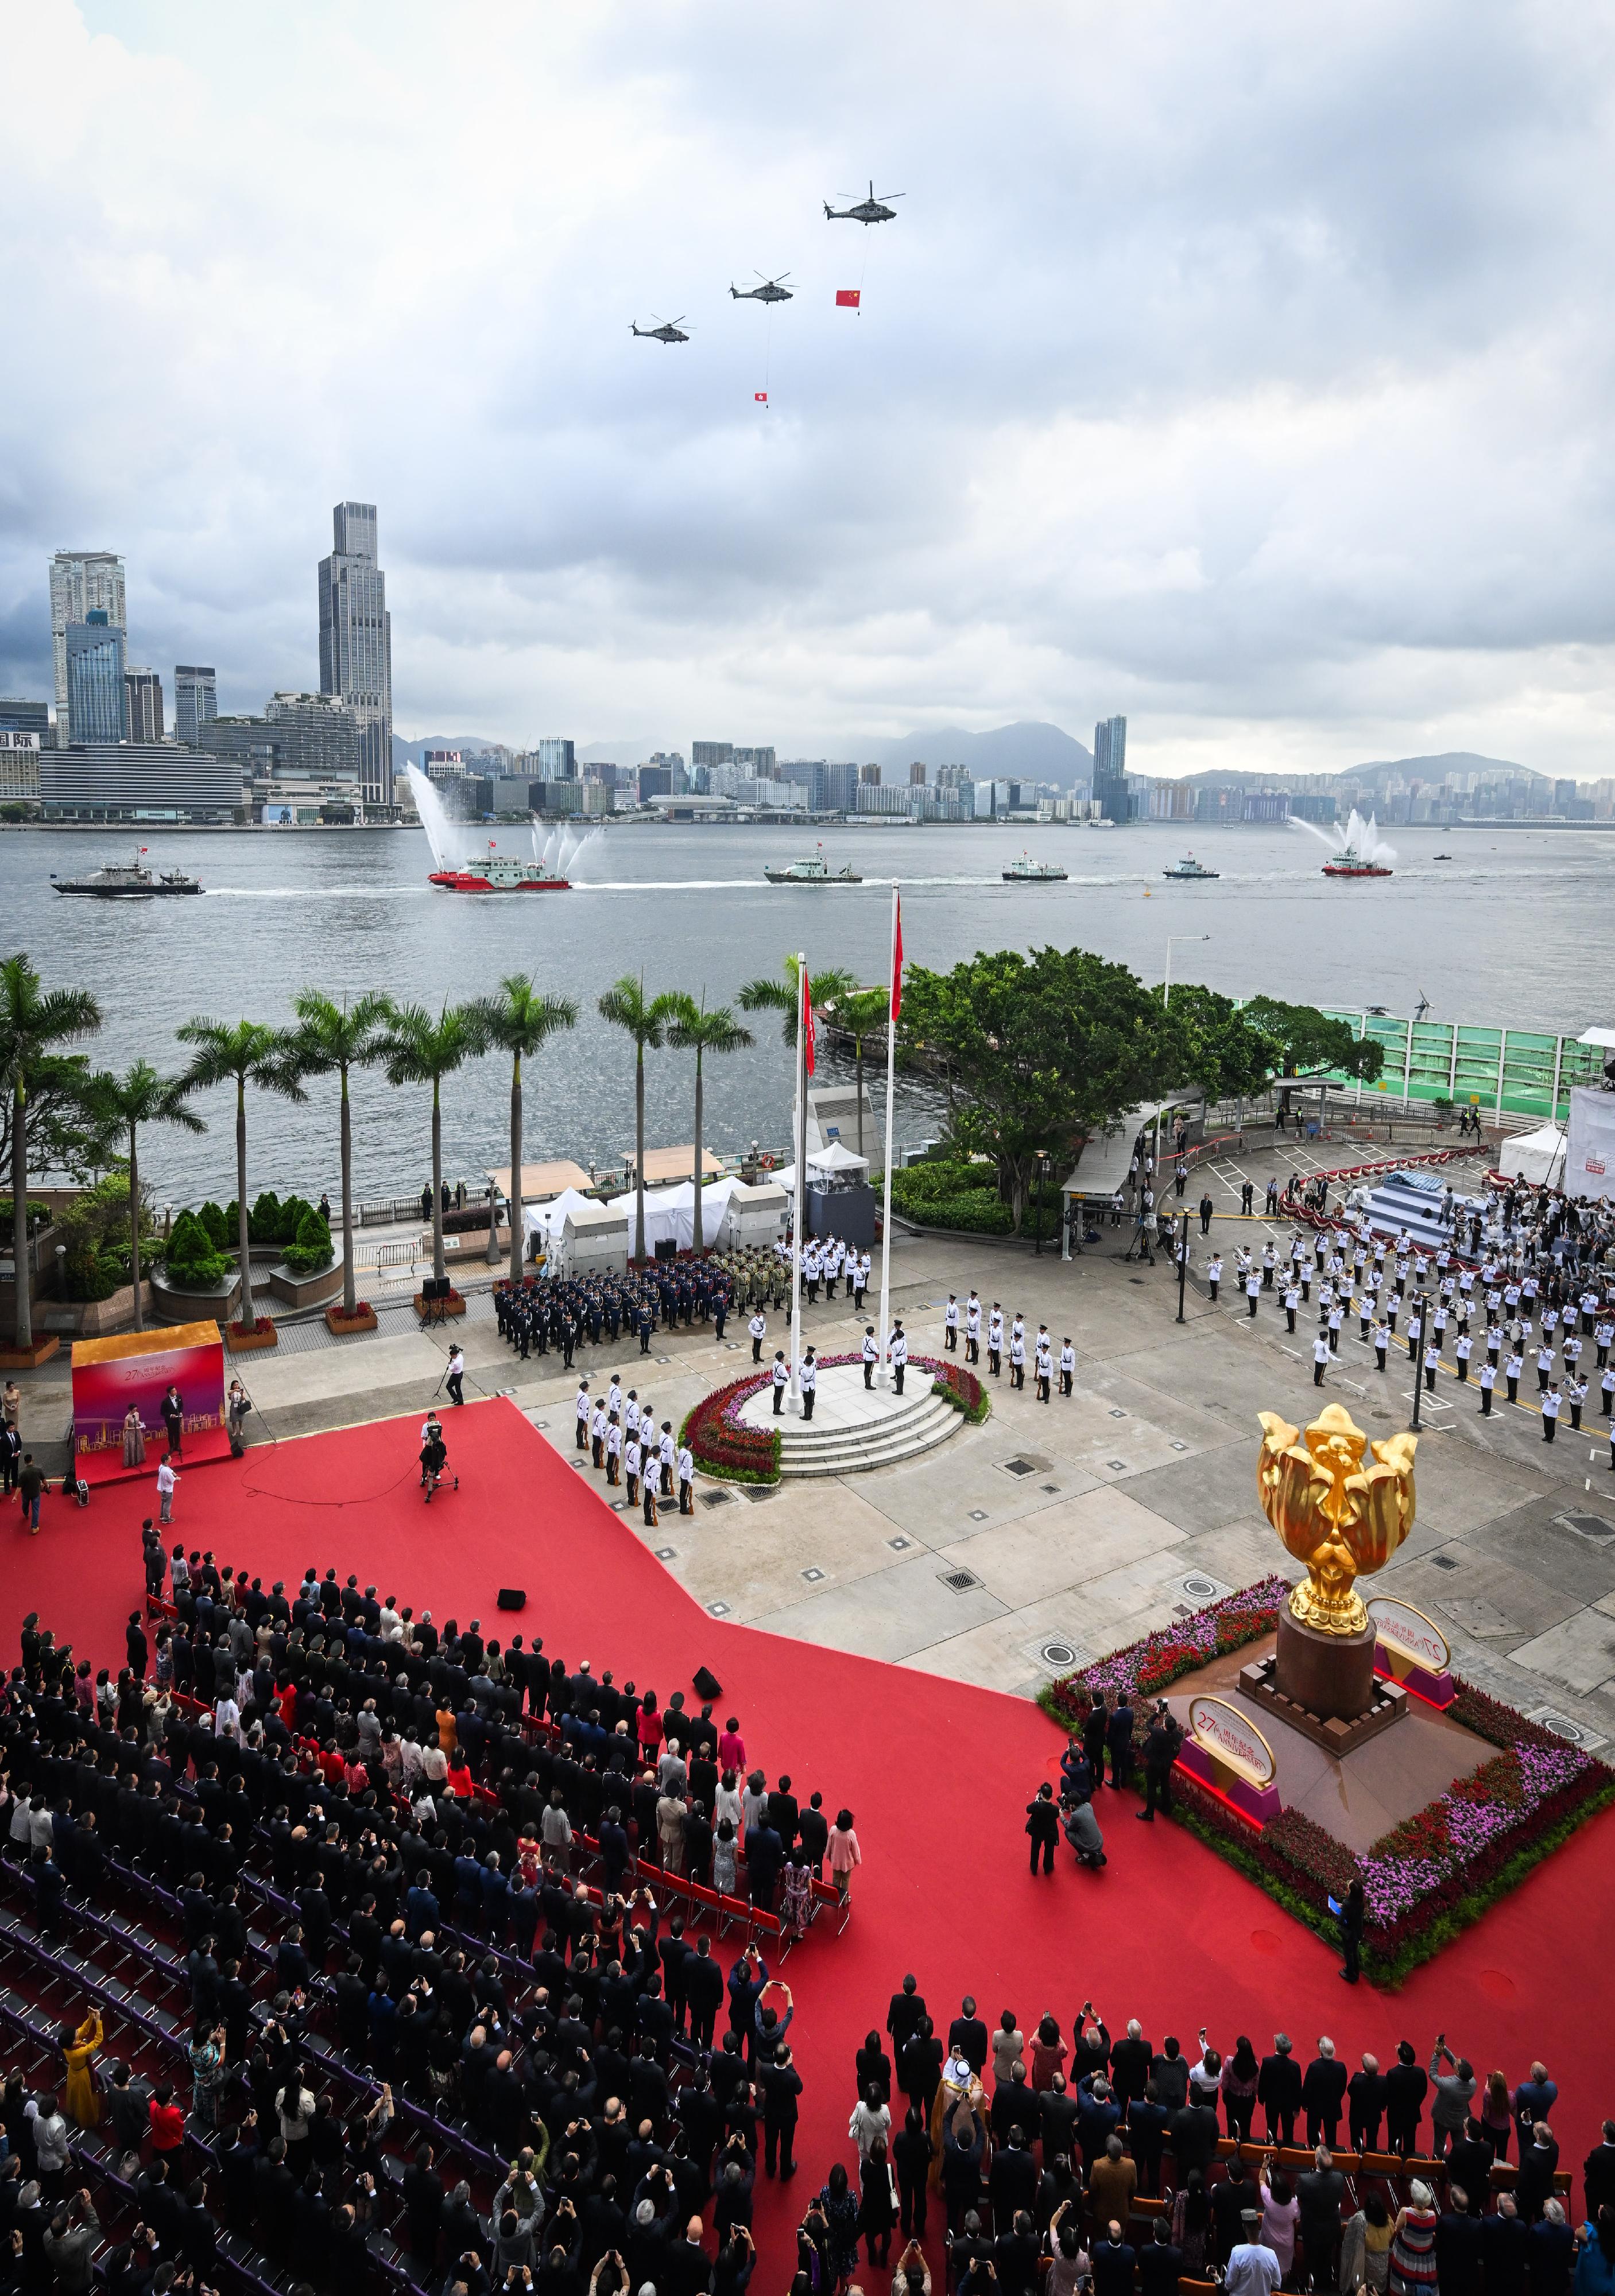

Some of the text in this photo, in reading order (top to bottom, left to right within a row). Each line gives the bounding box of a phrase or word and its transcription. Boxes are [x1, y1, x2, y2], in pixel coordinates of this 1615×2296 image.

[1218, 1733, 1263, 1771] ANNIVERSARY
[1223, 1728, 1254, 1757] 周年紀念
